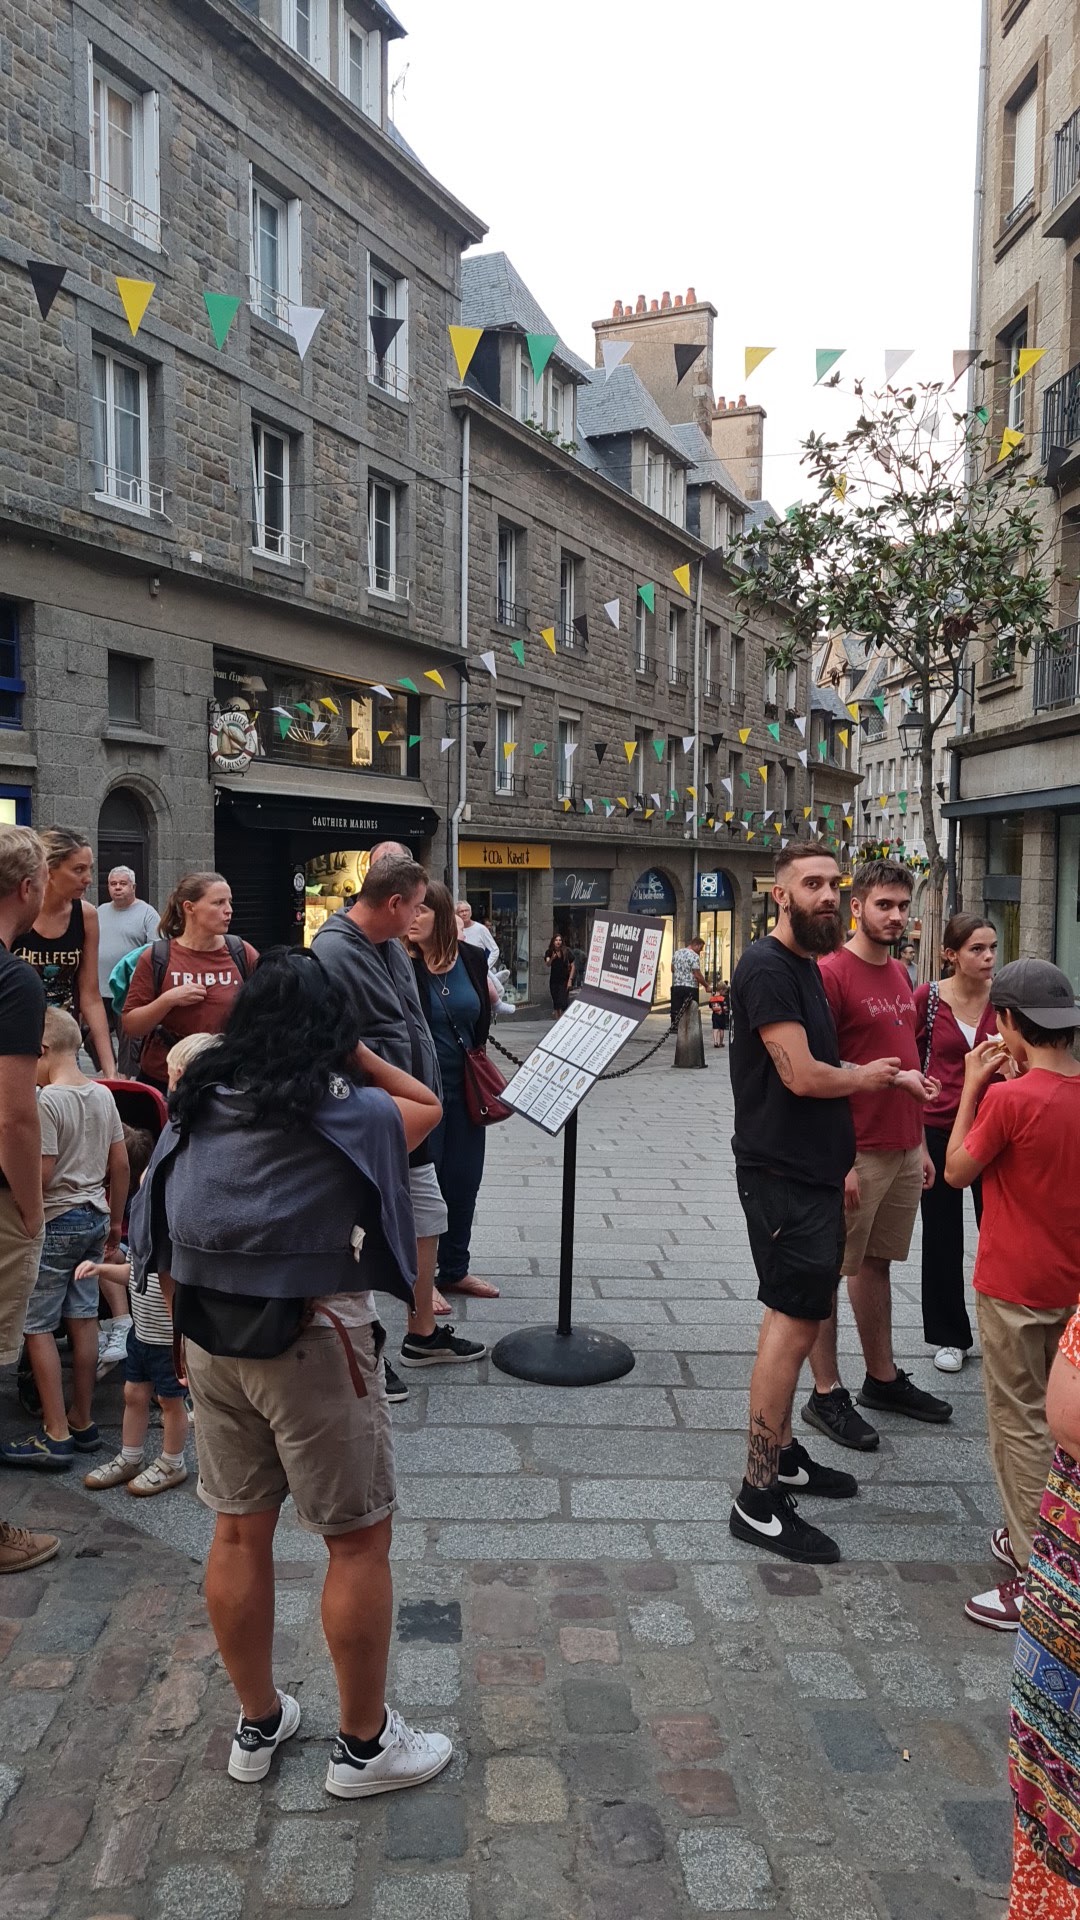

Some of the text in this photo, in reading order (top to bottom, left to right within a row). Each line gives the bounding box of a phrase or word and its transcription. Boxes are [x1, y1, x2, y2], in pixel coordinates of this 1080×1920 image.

[214, 713, 247, 729] GAUTHIER
[217, 756, 247, 769] MARINES
[312, 816, 378, 829] GAUTHIER MARINES
[611, 923, 641, 941] SANCHEZ
[612, 942, 633, 952] L'ARTISAN
[15, 947, 81, 971] HELLFEST
[612, 952, 630, 963] GLACIER
[170, 971, 239, 986] TRIBU.
